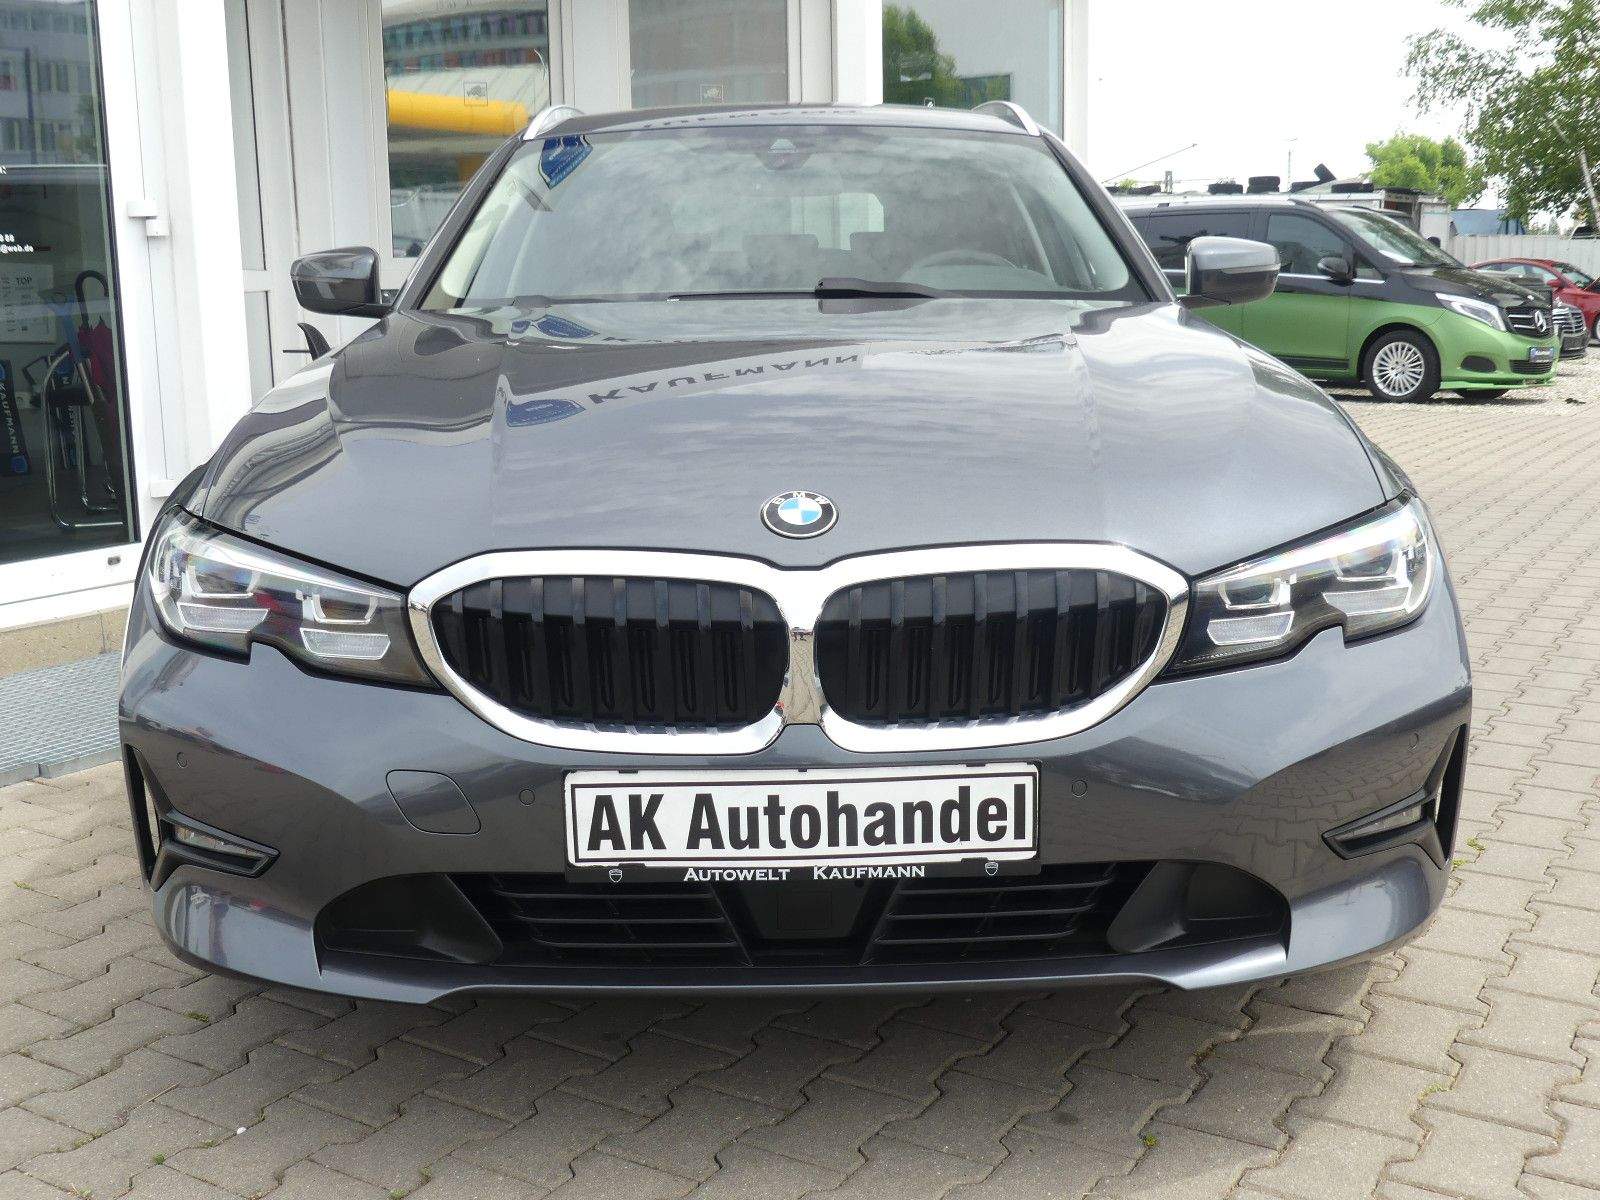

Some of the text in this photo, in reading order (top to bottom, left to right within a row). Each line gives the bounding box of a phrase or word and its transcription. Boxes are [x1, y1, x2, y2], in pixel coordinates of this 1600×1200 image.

[586, 782, 1027, 852] AK Autohandel
[683, 864, 925, 882] AUTOWELT KAUFMANN
